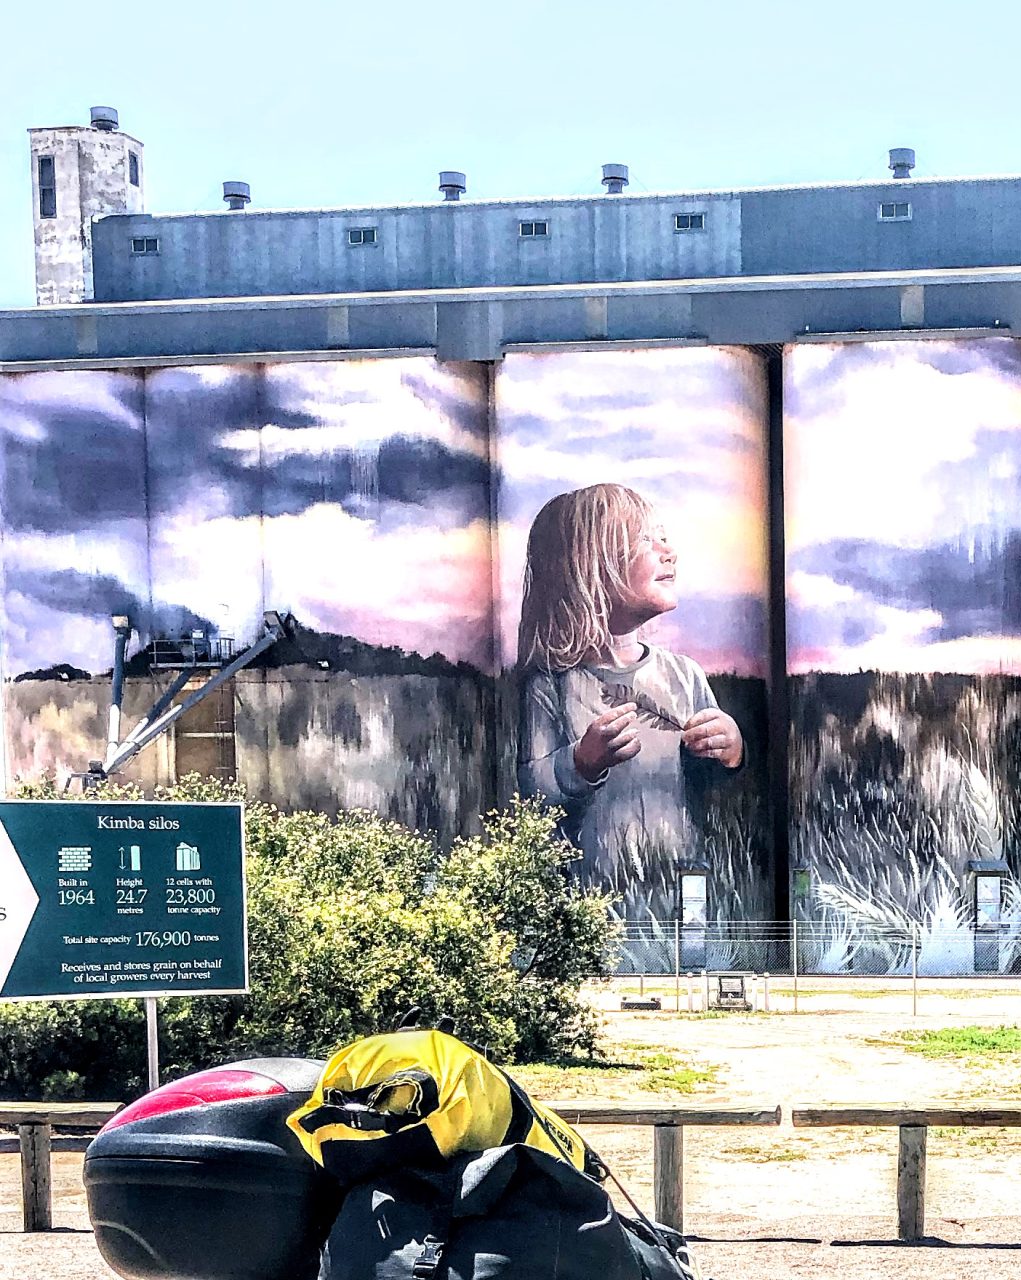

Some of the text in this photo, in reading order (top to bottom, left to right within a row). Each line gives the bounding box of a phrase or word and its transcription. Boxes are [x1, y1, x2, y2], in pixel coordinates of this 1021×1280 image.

[97, 815, 180, 830] Kimba silos
[58, 878, 88, 887] Built in
[116, 878, 143, 888] Height
[166, 878, 212, 886] 12 cells with
[58, 889, 95, 905] 1964
[116, 889, 148, 904] 24.7
[166, 888, 215, 906] 23,800
[167, 906, 221, 916] tonne capacity
[63, 930, 219, 948] Total site capacity 176,900 tonnes
[61, 959, 222, 973] Receives and stores grain on behalf
[73, 970, 211, 984] of local growers every harvest
